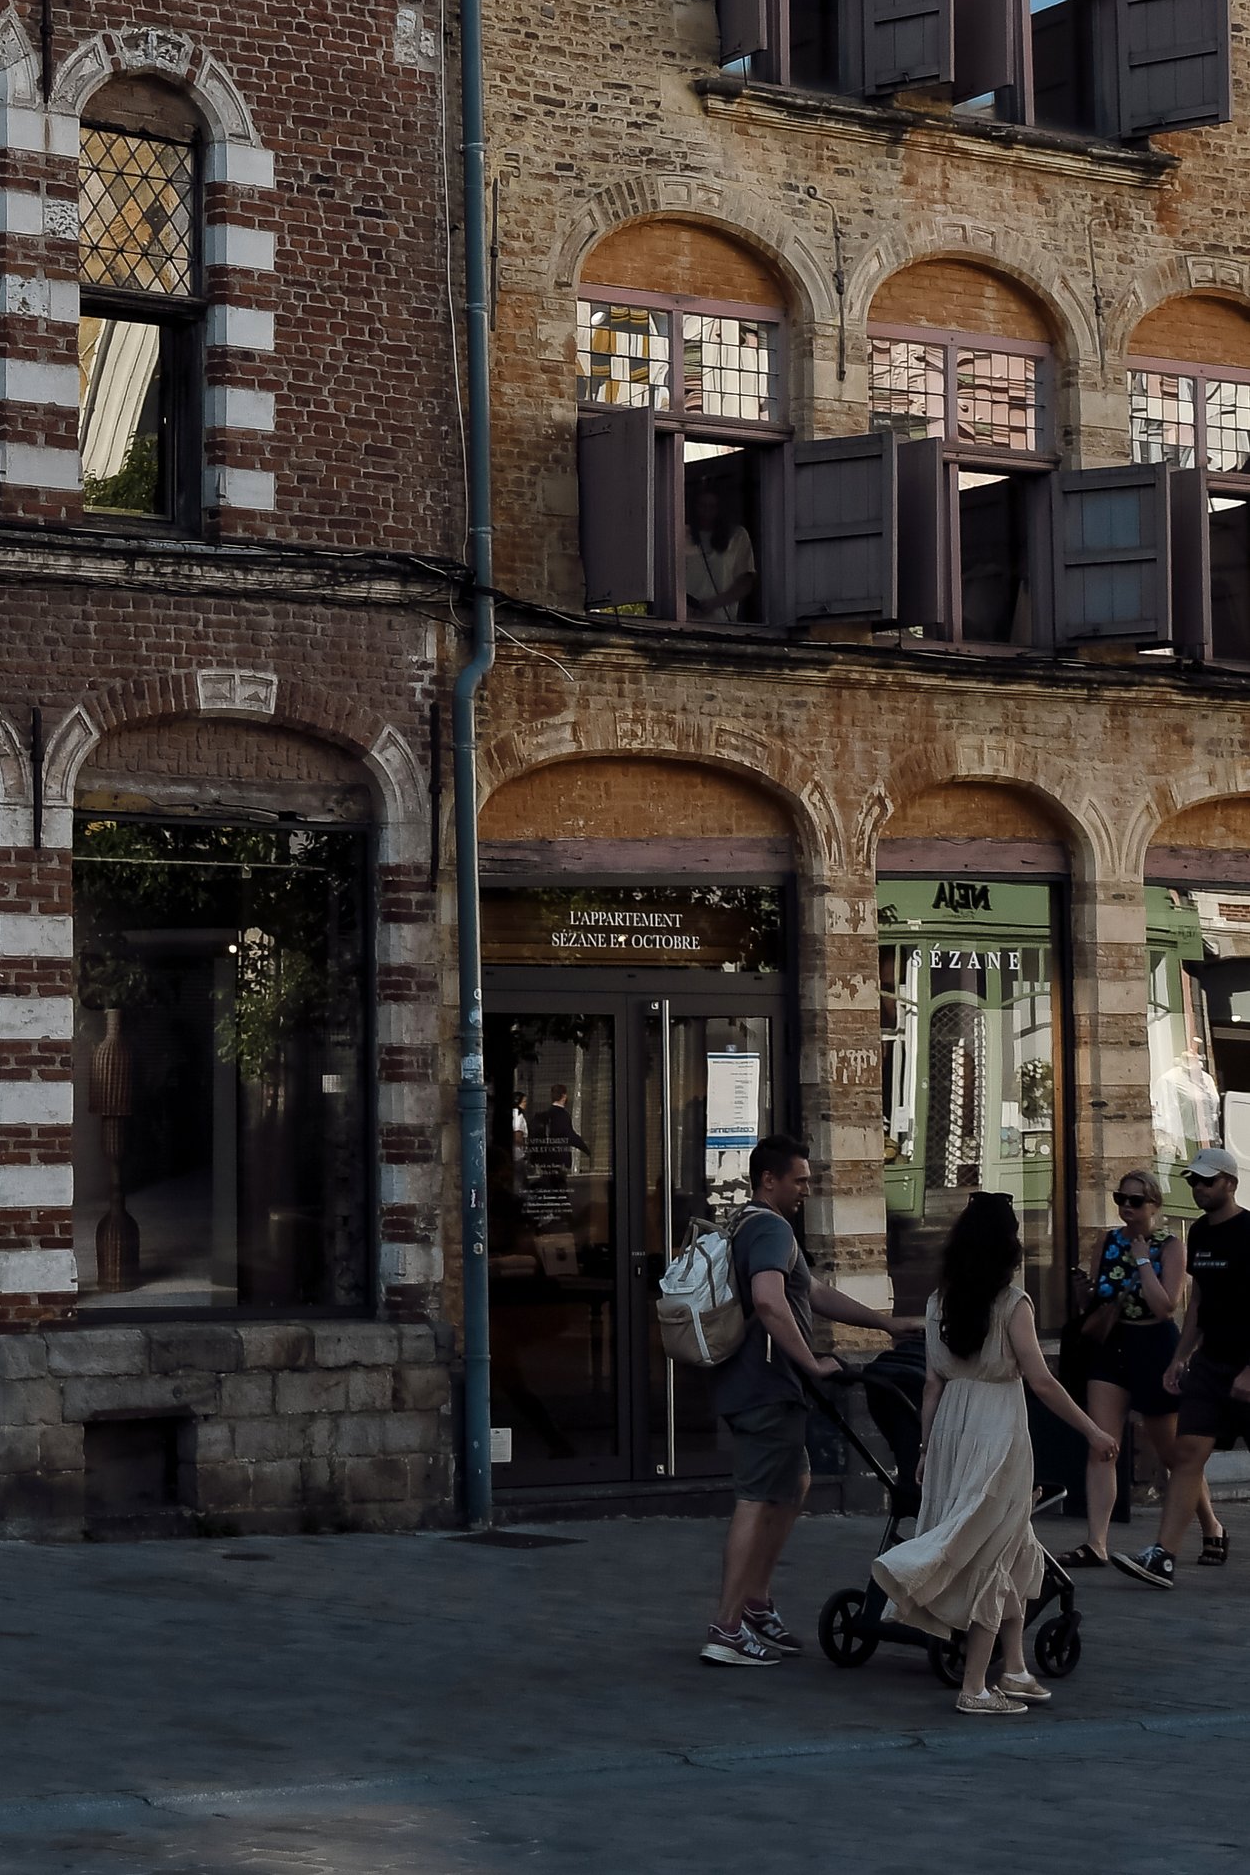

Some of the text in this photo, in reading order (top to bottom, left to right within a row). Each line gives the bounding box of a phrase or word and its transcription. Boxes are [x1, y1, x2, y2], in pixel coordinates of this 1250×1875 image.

[570, 910, 683, 928] L'APPARTEMENT
[551, 929, 701, 950] SÉZANE ET OCTOBRE
[912, 943, 1020, 970] SÉZANE
